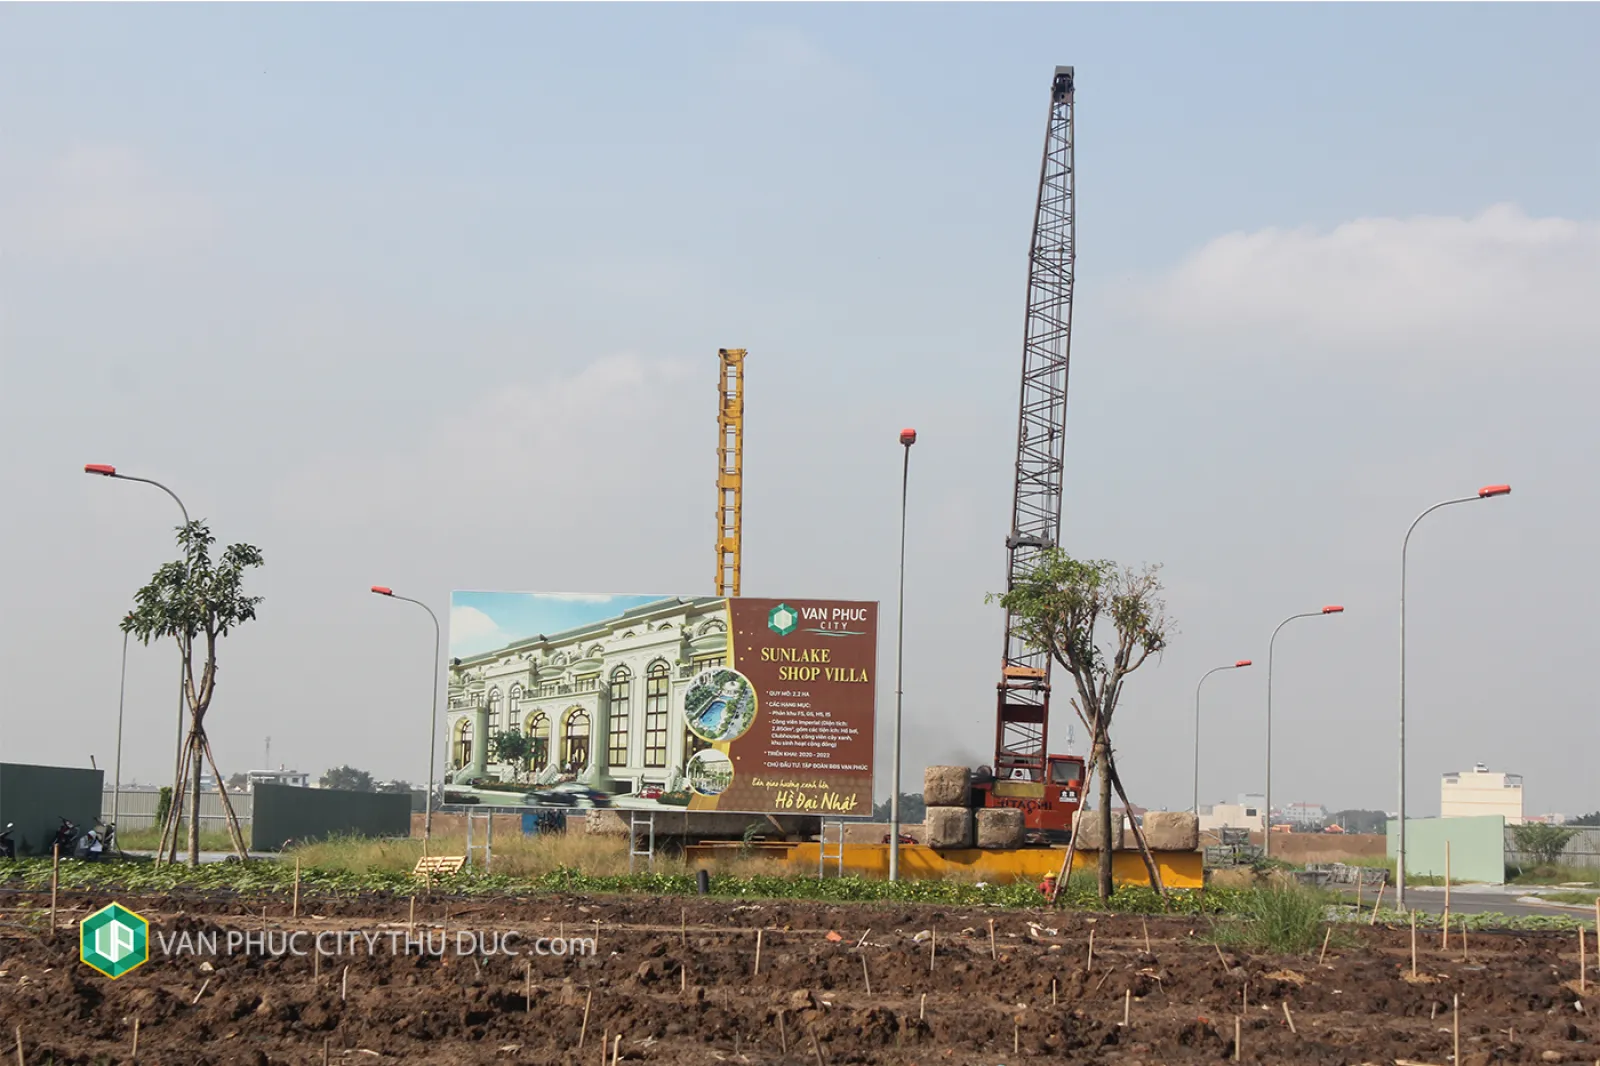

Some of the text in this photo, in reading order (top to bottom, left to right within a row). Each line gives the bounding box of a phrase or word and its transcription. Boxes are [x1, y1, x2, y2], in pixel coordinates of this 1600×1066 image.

[801, 608, 867, 621] VAN PHUC
[820, 622, 848, 630] CITY
[761, 647, 831, 663] SUNLAKE
[779, 666, 868, 682] SHOP VILLA
[775, 790, 858, 813] Hồ Đại Nhật
